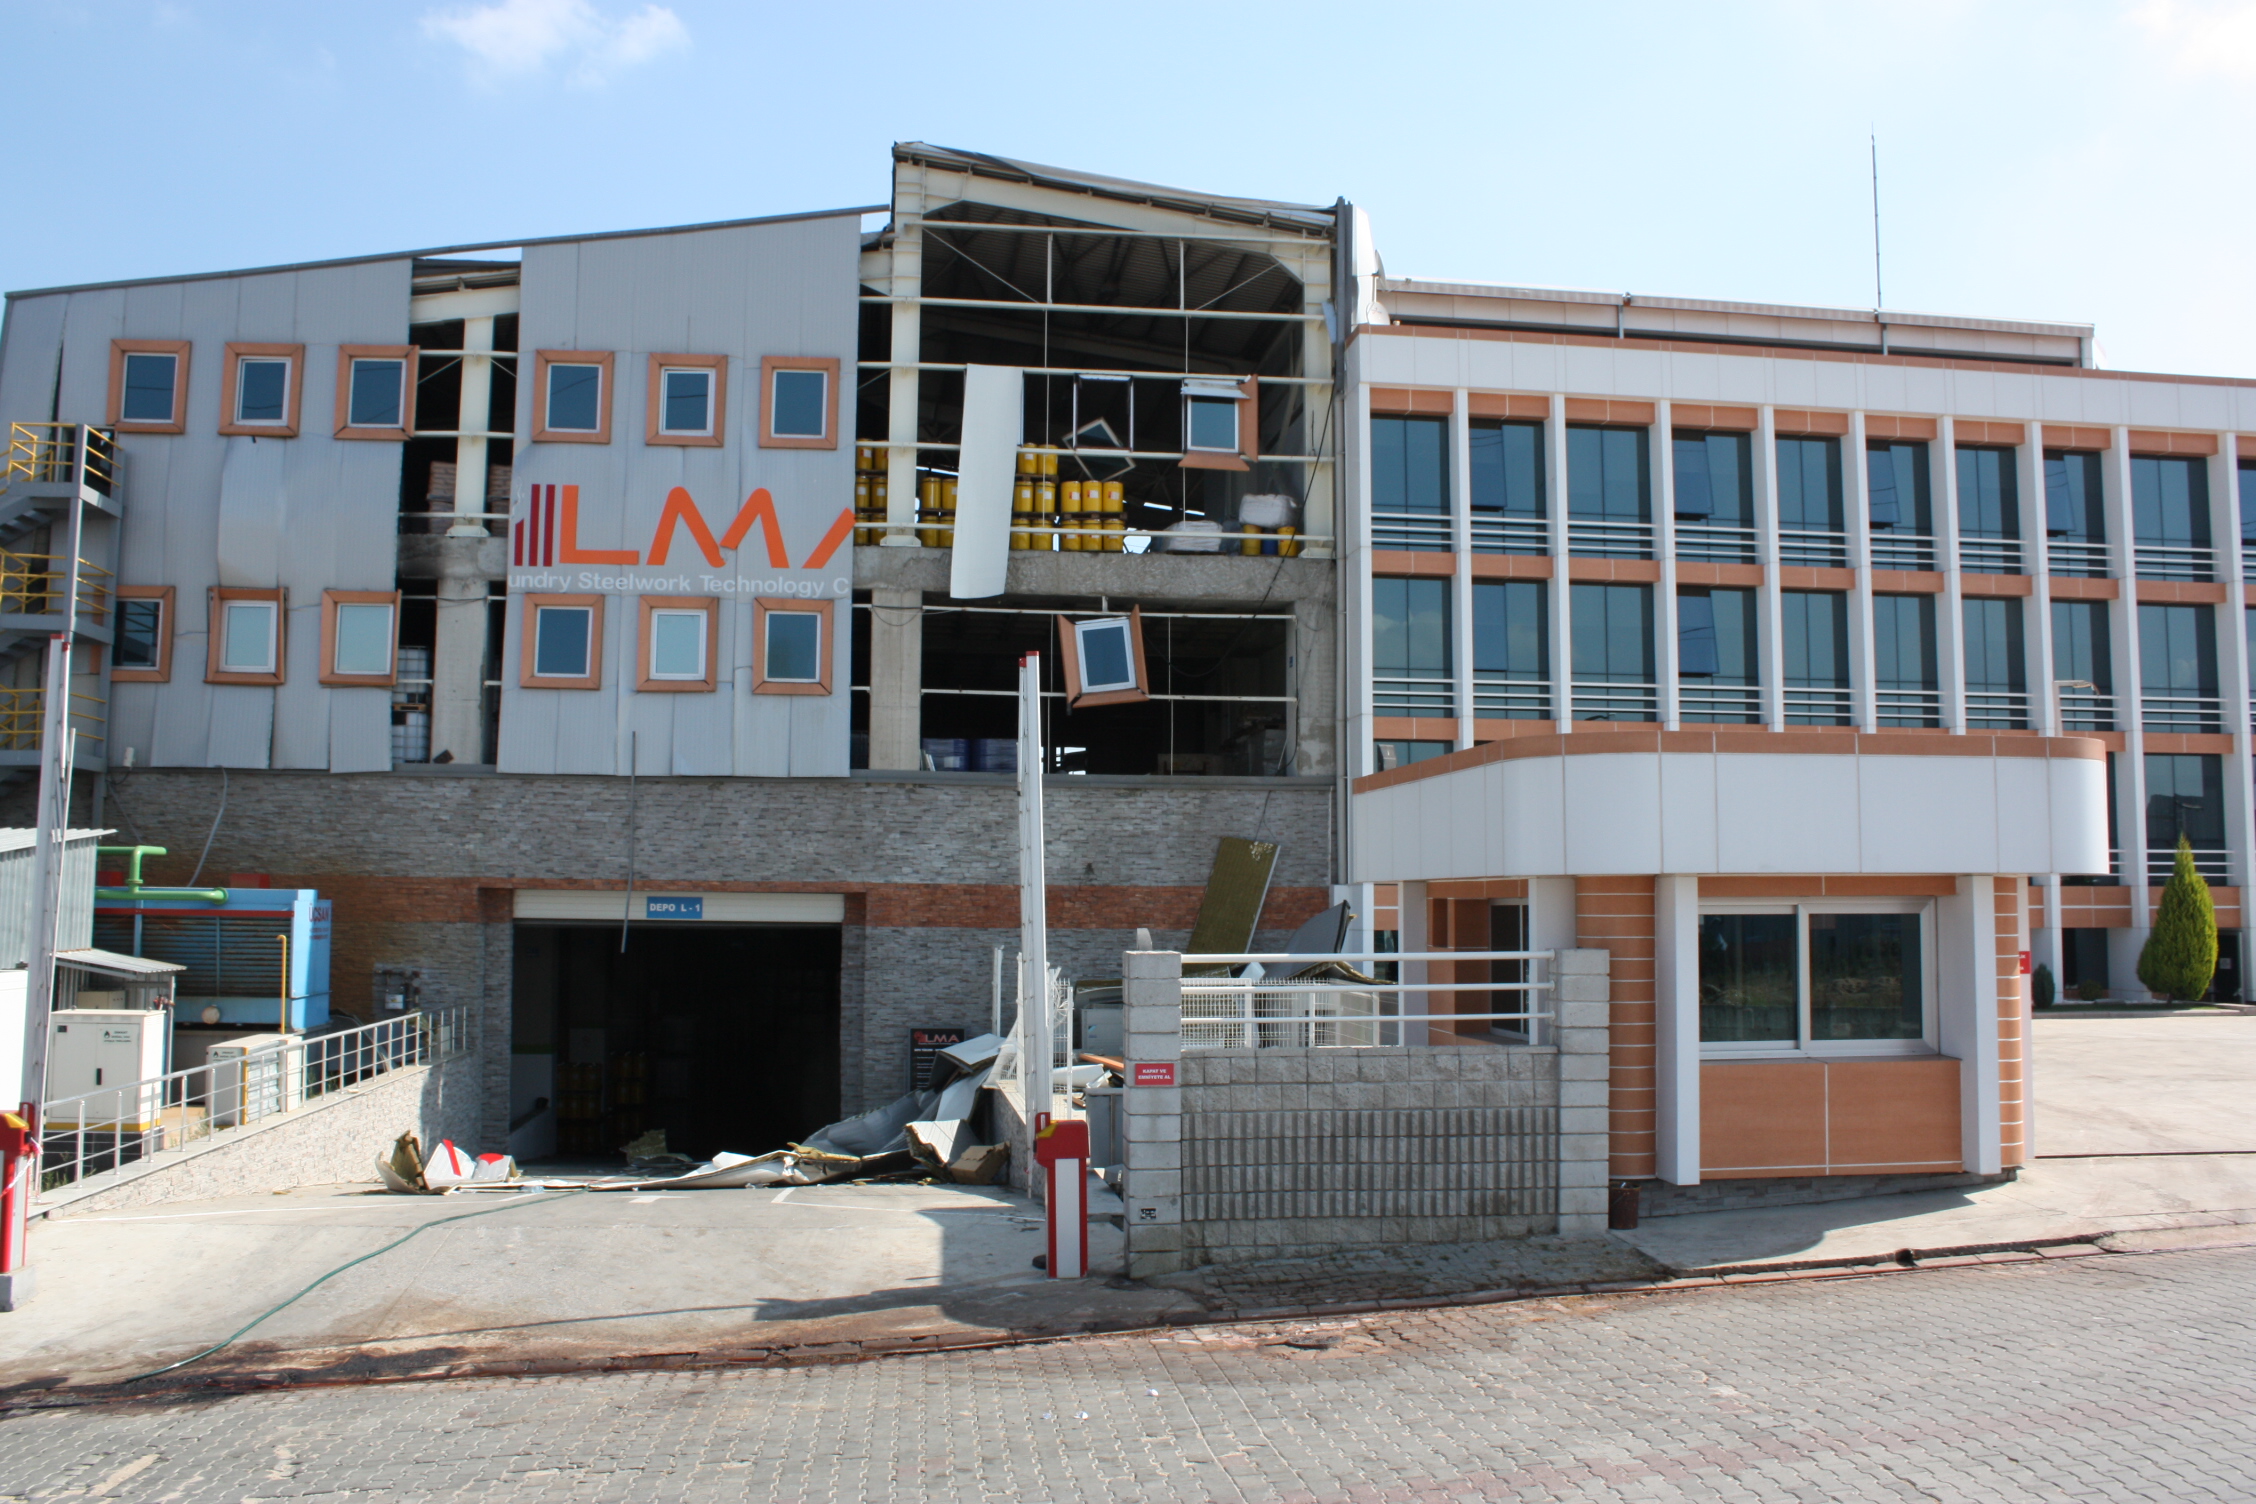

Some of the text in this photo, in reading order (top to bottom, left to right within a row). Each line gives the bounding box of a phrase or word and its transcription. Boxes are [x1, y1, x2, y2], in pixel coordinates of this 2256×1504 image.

[578, 572, 691, 592] Steelwork
[699, 575, 825, 598] Technology
[650, 903, 676, 911] DEPO
